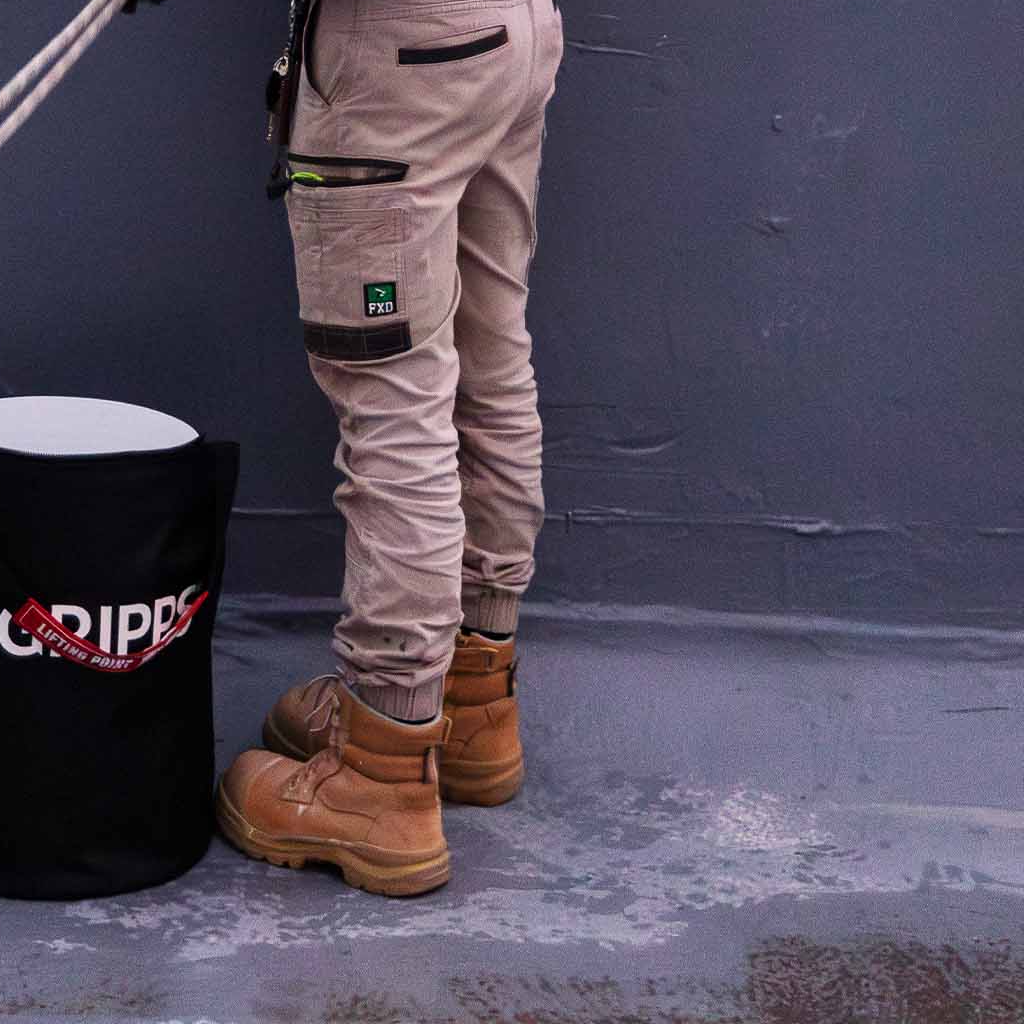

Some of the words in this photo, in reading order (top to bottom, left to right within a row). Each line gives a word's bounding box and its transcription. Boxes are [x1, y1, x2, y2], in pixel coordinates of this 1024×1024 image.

[368, 301, 394, 315] FXD
[36, 623, 89, 661] LIFTING
[90, 655, 134, 670] POINT
